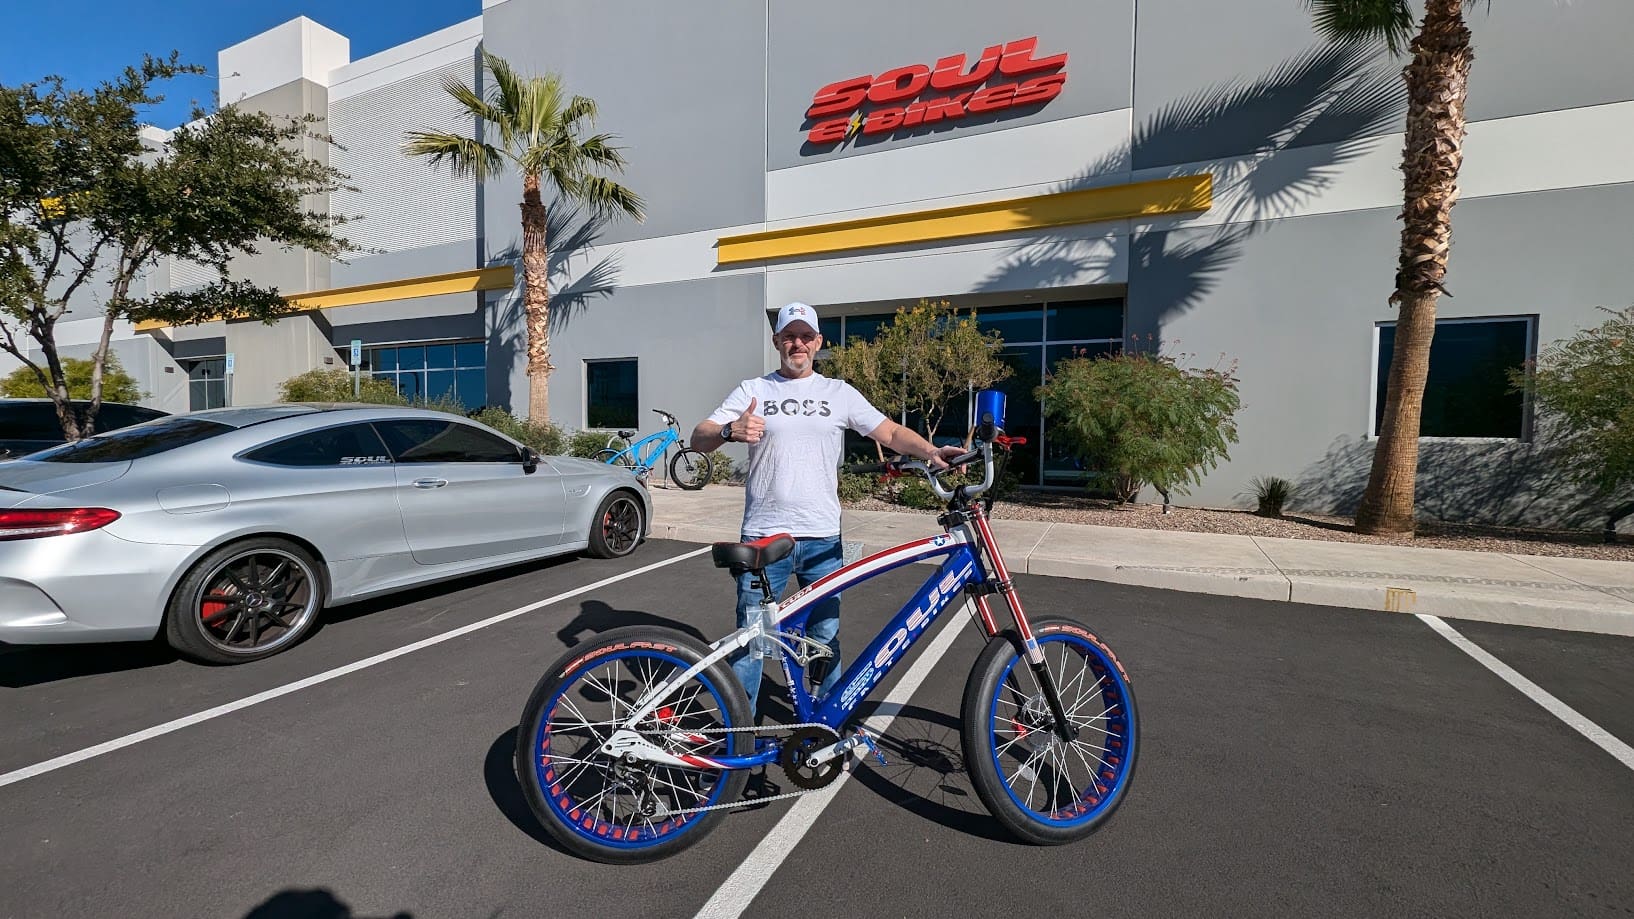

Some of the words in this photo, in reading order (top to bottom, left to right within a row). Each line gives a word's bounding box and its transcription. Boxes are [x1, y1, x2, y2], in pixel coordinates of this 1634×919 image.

[808, 36, 1068, 117] SOUL
[763, 398, 832, 417] BOSS
[584, 642, 630, 661] SOUL
[629, 641, 678, 653] FAST
[840, 560, 974, 710] SOUL
[1061, 624, 1101, 646] SOUL
[1099, 643, 1131, 683] FAST
